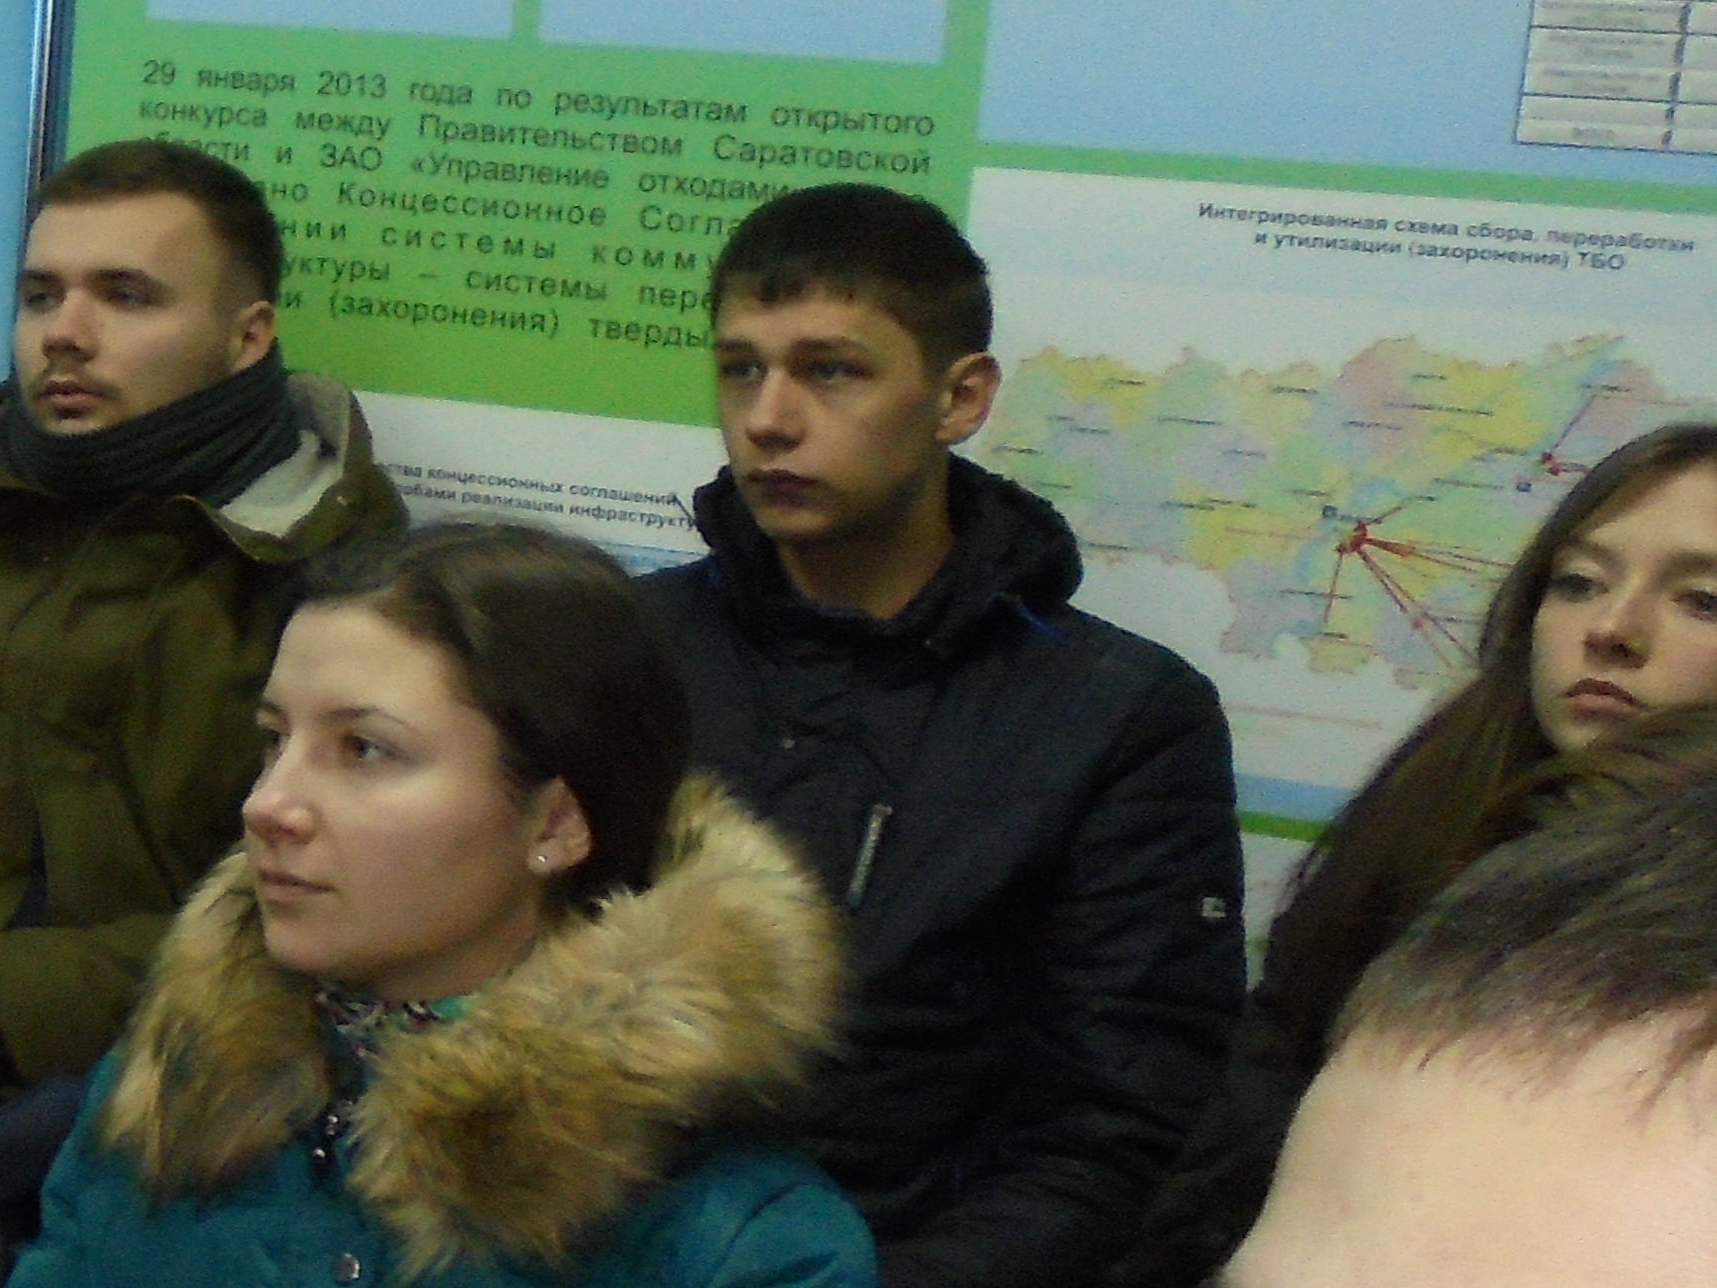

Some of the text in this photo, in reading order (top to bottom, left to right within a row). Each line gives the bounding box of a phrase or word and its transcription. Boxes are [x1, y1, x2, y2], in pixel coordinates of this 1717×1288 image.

[143, 59, 936, 137] 29 января 2013 года по результатам открытого
[139, 101, 931, 174] конкурса между Правительством Саратовской
[275, 146, 293, 164] и
[319, 143, 383, 172] ЗАО
[412, 150, 610, 190] «Управление
[337, 181, 607, 226] Концессионное
[381, 226, 557, 260] системы
[1198, 202, 1388, 231] Интегрированная
[1394, 218, 1459, 236] схема
[1546, 229, 1695, 252] переработки
[1254, 233, 1627, 271] и утилизации (захоронения) ТБО
[466, 270, 607, 301] системы
[328, 290, 559, 339] (захоронения)
[588, 317, 714, 349] тверды
[427, 466, 564, 495] концессионных
[569, 482, 682, 507] соглашений
[461, 489, 564, 514] реализации
